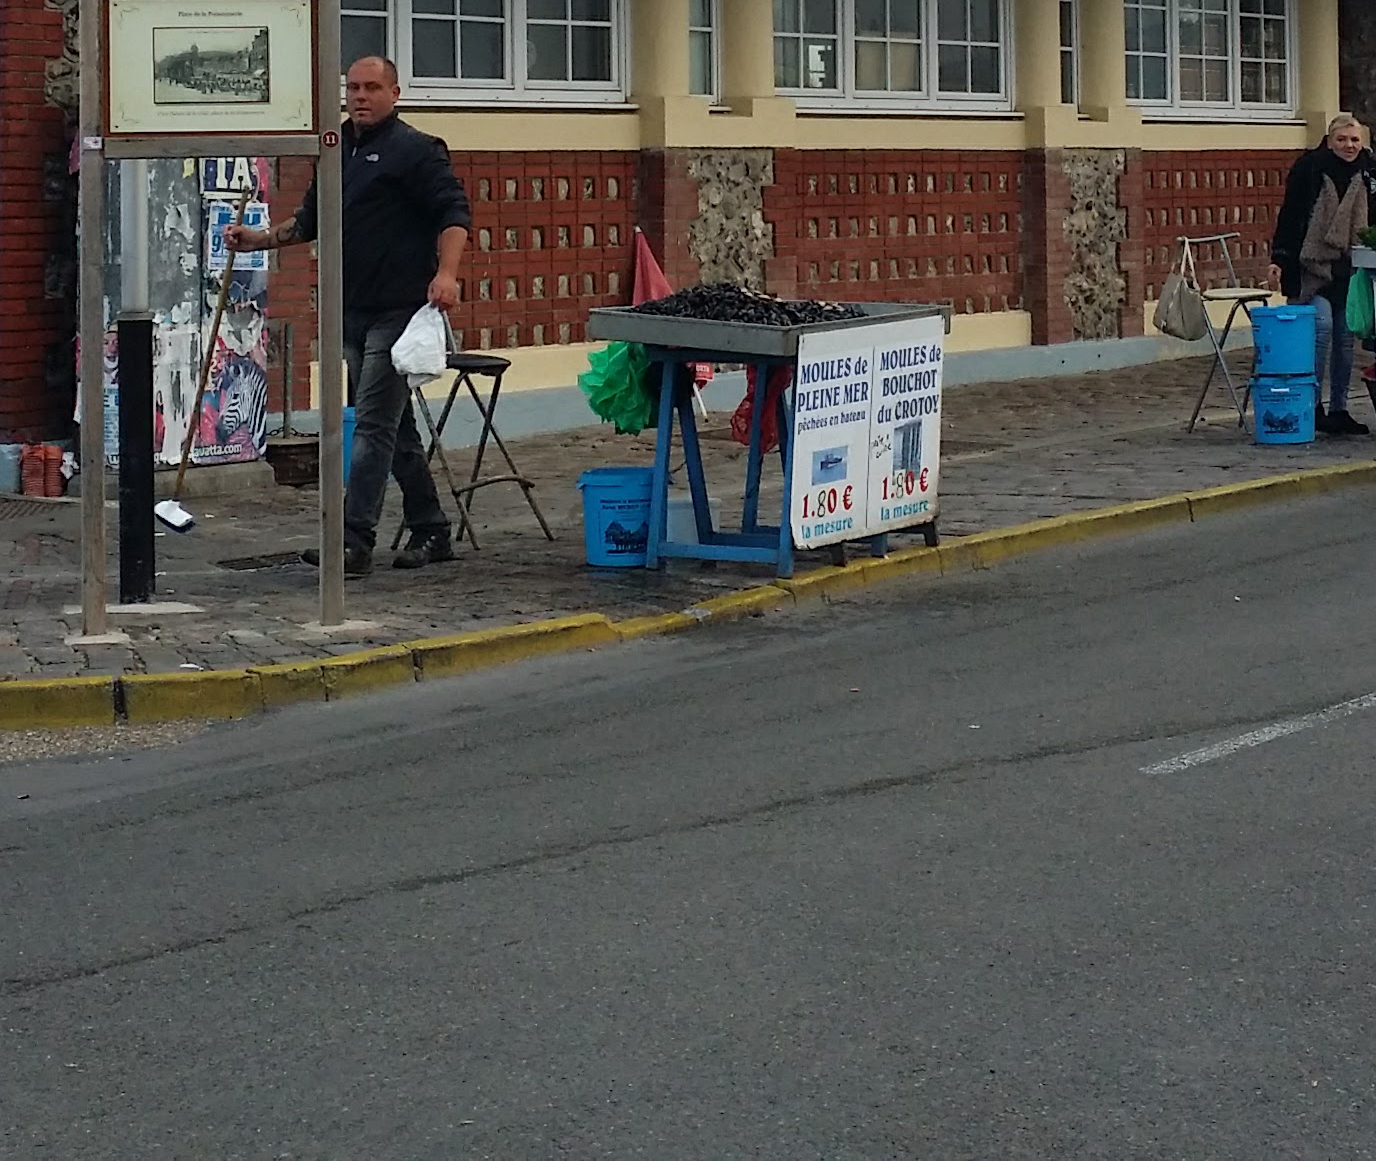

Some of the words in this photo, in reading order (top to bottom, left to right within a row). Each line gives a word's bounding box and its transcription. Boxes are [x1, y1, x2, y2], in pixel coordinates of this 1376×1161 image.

[326, 135, 335, 144] 11
[880, 345, 927, 371] MOULES
[929, 344, 941, 363] de
[800, 357, 852, 385] MOULES
[854, 356, 868, 376] de
[882, 369, 937, 397] BOUCHOT
[797, 386, 840, 413] PLEINE
[843, 381, 869, 405] MER
[829, 414, 839, 426] en
[840, 410, 866, 424] bateau
[877, 405, 892, 424] du
[919, 467, 929, 492] €
[802, 488, 837, 518] 1.80
[842, 485, 853, 511] €
[880, 506, 890, 521] la
[893, 500, 929, 519] mesure
[801, 524, 811, 539] la
[814, 518, 853, 537] mesure
